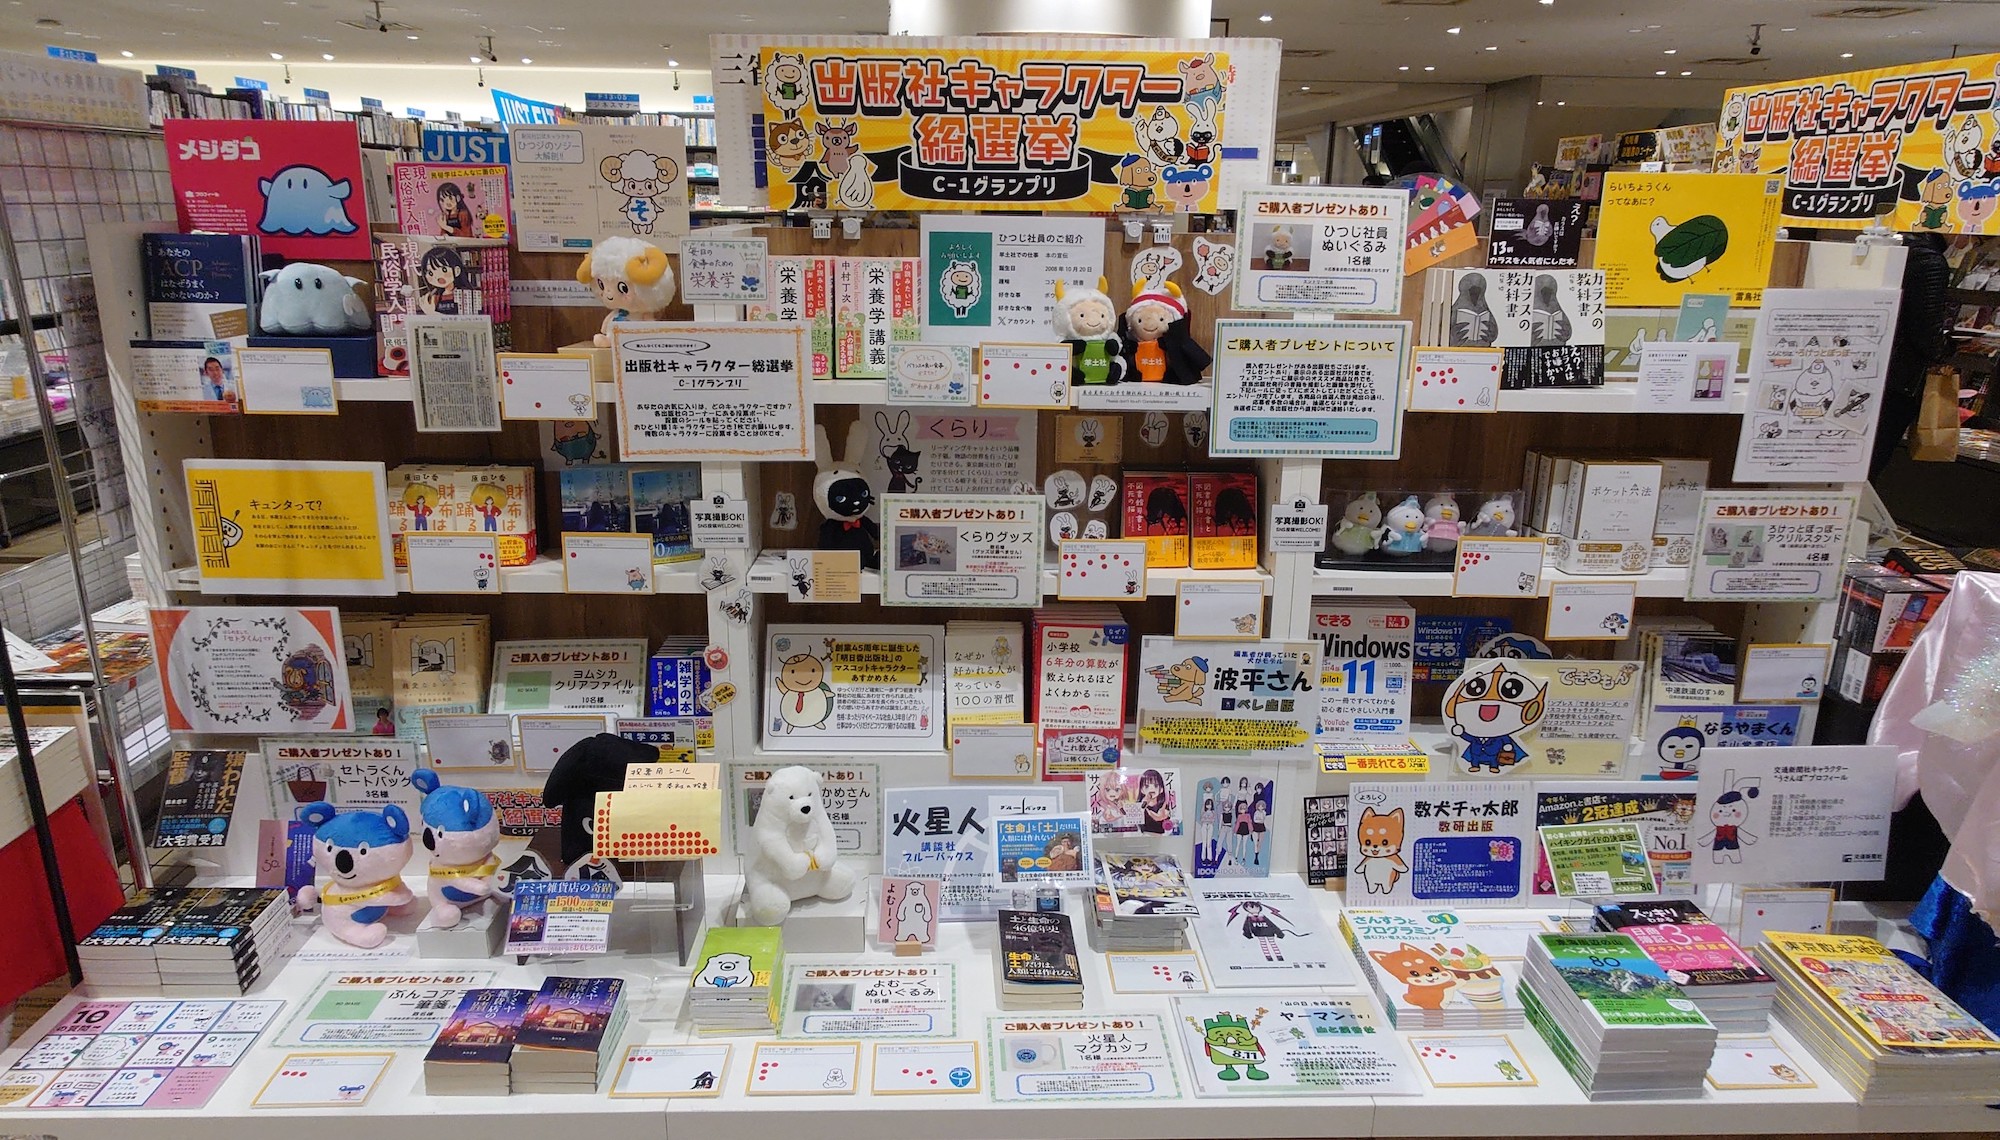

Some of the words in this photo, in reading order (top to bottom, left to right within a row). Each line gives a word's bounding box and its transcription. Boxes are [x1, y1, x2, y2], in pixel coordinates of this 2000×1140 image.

[812, 57, 1182, 112] 出版社キャラクター
[1746, 74, 1993, 135] 出版社キャラクター
[915, 112, 1078, 164] 総選挙
[179, 138, 260, 161] メジダコ
[427, 135, 505, 163] JUST
[1790, 133, 1899, 184] 総選挙
[413, 167, 429, 194] 現代
[932, 174, 1056, 196] C-1グランプリ
[1608, 181, 1672, 192] らいちょうくん
[1257, 201, 1388, 217] ご購入者プレゼントあり！
[1792, 193, 1874, 214] C-1グランプリ
[1324, 225, 1388, 239] ひつじ社員
[999, 233, 1084, 244] ひつじ社員のご紹介
[1321, 240, 1387, 254] ぬいぐるみ
[401, 240, 422, 277] 現代
[1045, 251, 1069, 259] 本の宣伝
[1346, 255, 1372, 266] 1名様
[161, 259, 203, 277] ACP
[690, 270, 735, 289] 栄養学
[841, 260, 852, 304] 中村丁次
[780, 266, 798, 322] 栄養学
[1505, 272, 1521, 318] 教科書
[1577, 272, 1592, 317] 教科書
[1734, 291, 1761, 302] 雷鳥社
[1519, 272, 1534, 331] カラスの
[1591, 272, 1604, 330] カラスの
[869, 266, 887, 366] 栄養学講義
[1227, 338, 1396, 352] ご購入者プレゼントについて
[625, 359, 794, 374] 出版社キャラクター総選挙
[1084, 357, 1108, 367] 羊土社
[1141, 357, 1164, 367] 羊土社
[678, 378, 743, 389] C-1グランプリ
[930, 418, 989, 439] くらり
[404, 473, 439, 482] 原田ひ香
[471, 474, 507, 483] 原田ひ香
[1591, 483, 1652, 497] ポケット六法
[432, 483, 455, 531] 財布は
[502, 484, 524, 531] 財布は
[1135, 481, 1143, 532] 図書館司書と
[1203, 483, 1212, 533] 図書館司書と
[1716, 505, 1838, 517] ご購入者プレゼントあり！
[389, 501, 408, 531] 踊る
[456, 501, 478, 531] 踊る
[694, 512, 745, 522] 写真撮影OK!
[899, 508, 1025, 520] ご購入者プレゼントあり！
[1274, 516, 1324, 526] 写真撮影OK!
[959, 531, 1034, 544] くらりグッズ
[1766, 533, 1842, 544] アクリルスタンド
[1806, 552, 1830, 562] 4名様
[1315, 614, 1352, 628] できる
[834, 643, 920, 653] 創業45周年に誕生した
[1046, 642, 1081, 654] 小学校
[1312, 632, 1412, 660] Windows
[1414, 642, 1457, 657] できる
[510, 651, 628, 664] ご購入者プレゼントあり！
[835, 653, 903, 663] 「明日香出版社」の
[954, 652, 985, 661] なぜか
[834, 663, 915, 672] マスコットキャラクター
[1046, 657, 1119, 669] 6年分の算数が
[573, 668, 618, 680] ヨムシカ
[953, 664, 1016, 676] 好かれる人が
[851, 673, 898, 683] あすかめさん
[1046, 673, 1116, 685] 教えられるほど
[1213, 666, 1314, 693] 波平さん
[1342, 659, 1377, 695] 11
[1558, 668, 1631, 691] できるもん
[555, 680, 635, 692] クリアファイル
[678, 659, 693, 714] 雑学の本
[954, 680, 1002, 691] やっている
[581, 695, 605, 705] 10名様
[1045, 690, 1091, 699] よくわかる
[1237, 699, 1295, 713] ベレ出版
[1321, 697, 1397, 706] この一冊ですべてわかる
[1321, 706, 1396, 715] 初心者にやさしい入門書
[1323, 718, 1351, 727] YouTube
[1703, 721, 1794, 737] なるやまくん
[1067, 736, 1099, 745] お父さん
[278, 747, 402, 758] ご購入者プレゼントあり！
[1062, 744, 1102, 753] これ教えて
[339, 764, 405, 775] セトラくん
[1347, 757, 1407, 770] 一番売れてる
[1773, 765, 1849, 774] 交通新聞社キャラクター
[213, 751, 247, 814] 嫌われた
[337, 776, 412, 788] トートバッグ
[365, 790, 390, 799] 3名様
[1089, 773, 1101, 817] サバイバル
[1359, 794, 1383, 802] よろしく
[1413, 799, 1520, 818] 数犬チャ太郎
[1581, 800, 1641, 823] 2冠達成
[892, 806, 986, 838] 火星人
[1438, 820, 1494, 833] 数研出版
[161, 834, 226, 848] 大宅賞受賞
[921, 841, 957, 853] 講談社
[1653, 832, 1689, 851] No.1
[902, 852, 975, 863] ブルーバックス
[518, 882, 614, 895] ナミヤ雑貨店の奇蹟
[886, 883, 896, 929] よむーく
[1009, 916, 1060, 925] 土と生命の
[1352, 915, 1419, 926] さんすうと
[1628, 908, 1679, 921] スッキリ
[1357, 925, 1452, 937] プログラミング
[88, 937, 155, 946] 大宅賞受賞
[162, 936, 231, 946] 大宅賞受賞
[1561, 947, 1632, 955] ベストコース
[1588, 954, 1622, 968] 80
[805, 968, 938, 978] ご購入者プレゼントあり！
[337, 975, 475, 985] ご購入者プレゼントあり！
[872, 979, 930, 989] よむーく
[864, 988, 937, 998] ぬいぐるみ
[72, 1009, 109, 1025] 10
[1003, 1020, 1145, 1032] ご購入者プレゼントあり！
[1087, 1033, 1133, 1043] 火星人
[1073, 1042, 1149, 1054] マグカップ
[1231, 1049, 1258, 1061] 8.11
